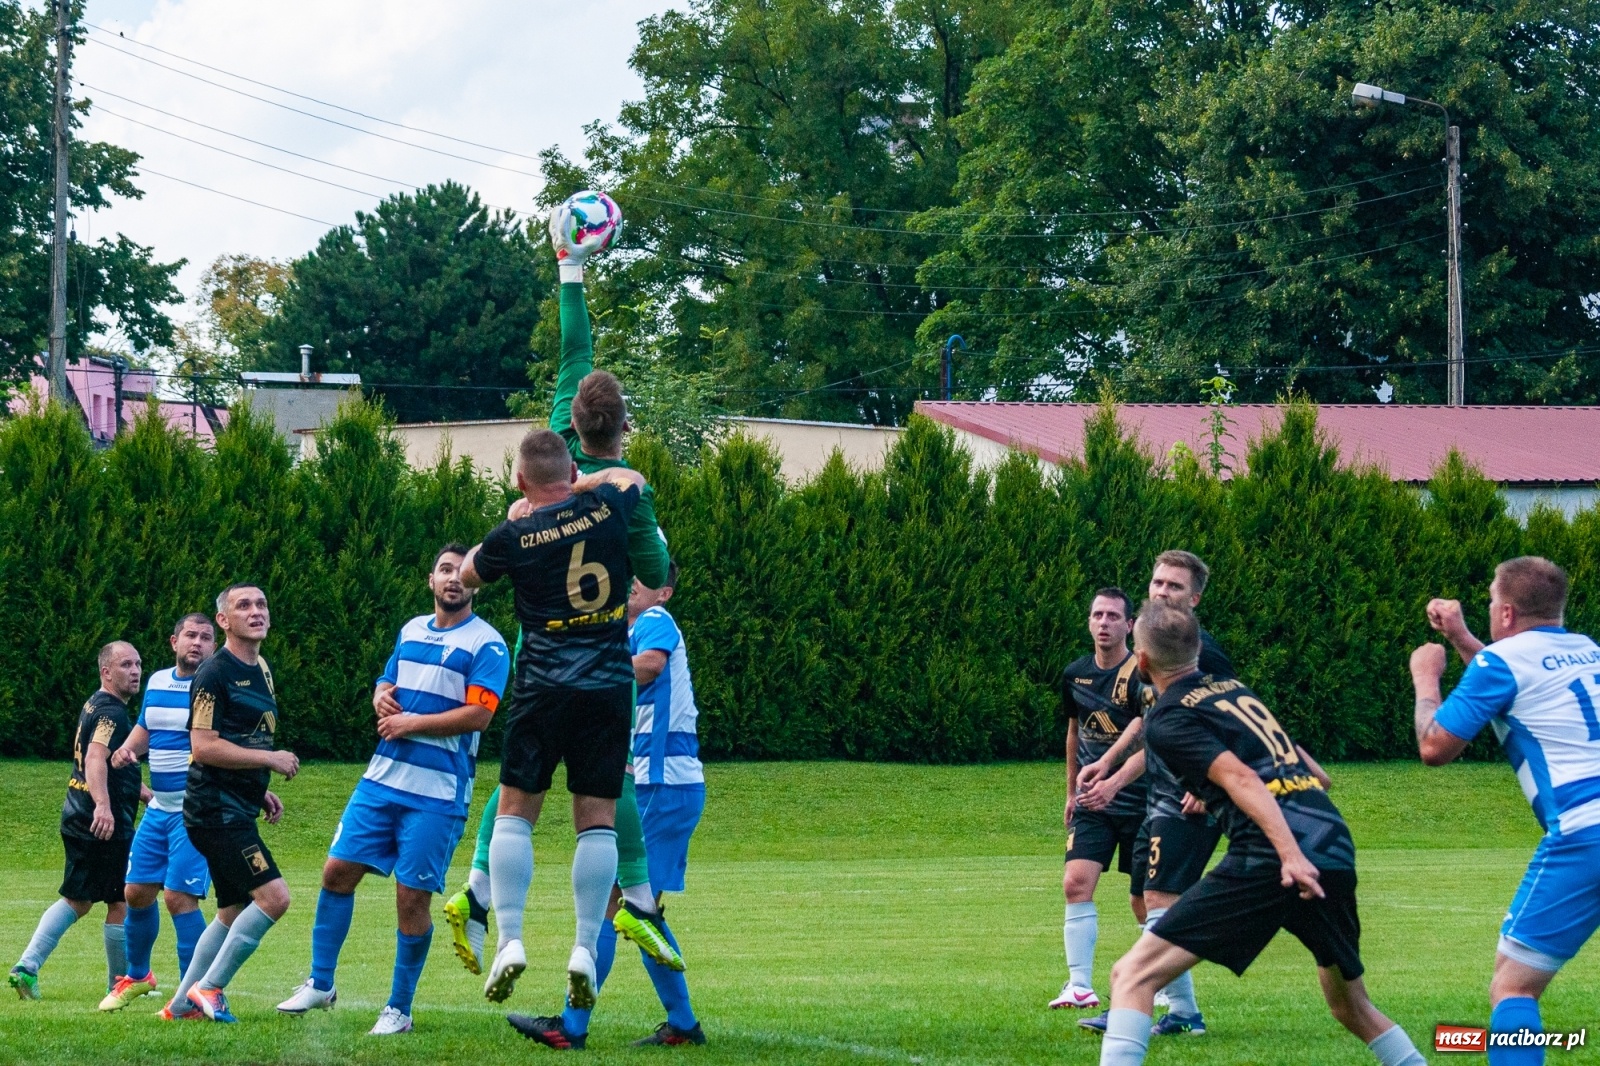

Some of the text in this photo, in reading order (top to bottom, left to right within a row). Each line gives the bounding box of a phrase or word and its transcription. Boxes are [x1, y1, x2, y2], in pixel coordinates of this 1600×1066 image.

[520, 526, 561, 549] CZARNI
[561, 516, 593, 537] NOWA
[566, 540, 611, 613] 6
[479, 689, 492, 705] C
[1567, 673, 1600, 741] 1
[1213, 695, 1299, 768] 18
[1148, 836, 1161, 866] 3
